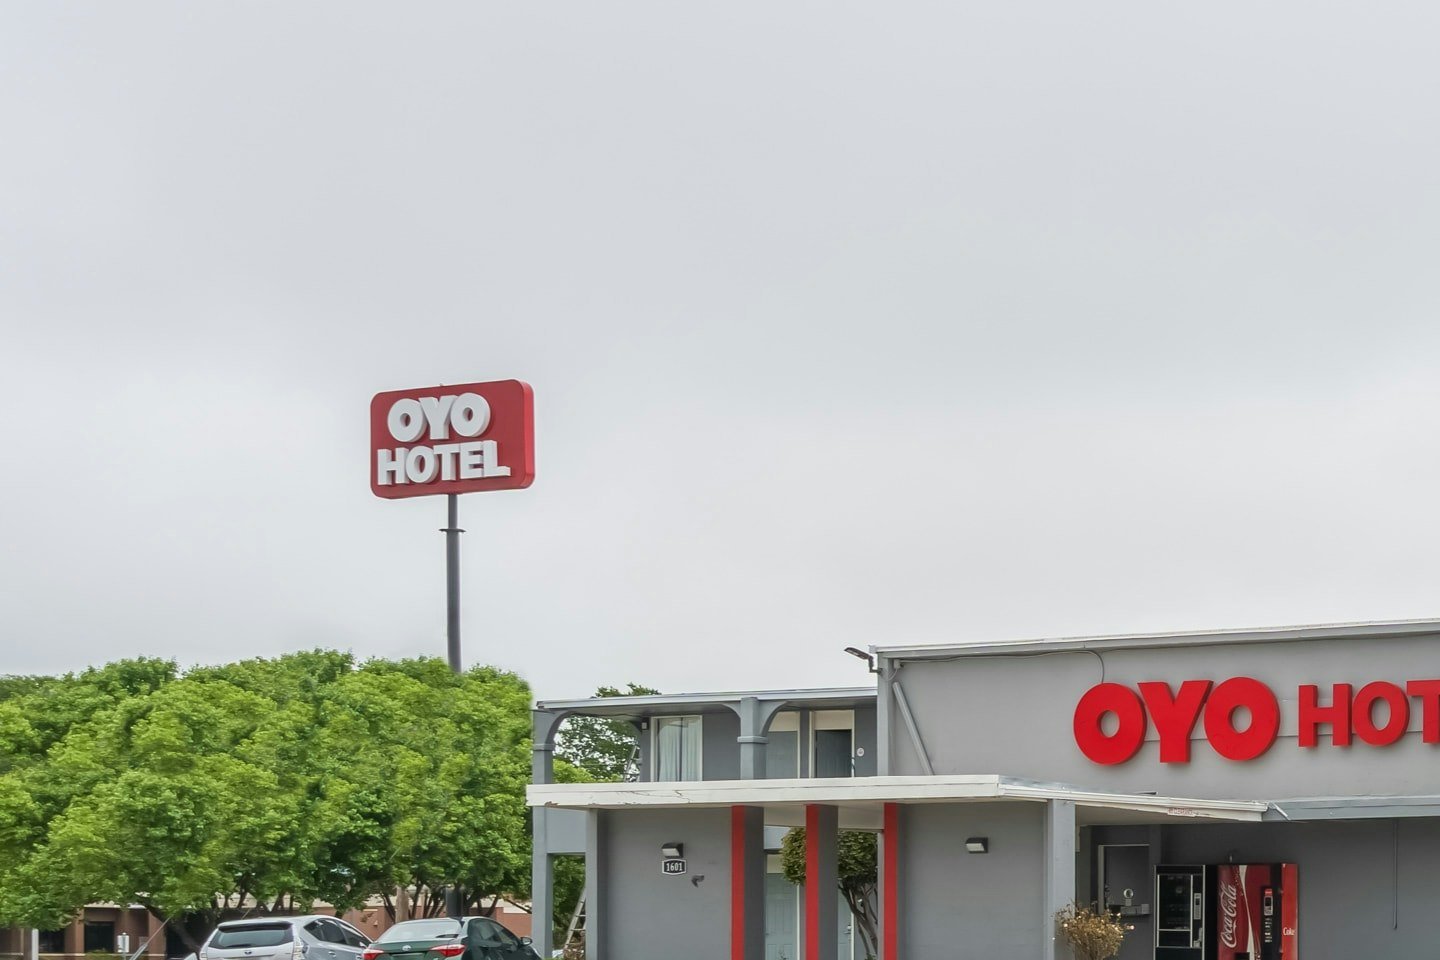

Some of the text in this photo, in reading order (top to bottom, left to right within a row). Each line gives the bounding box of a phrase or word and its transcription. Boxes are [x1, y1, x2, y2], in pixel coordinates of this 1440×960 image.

[387, 392, 491, 442] OYO
[377, 440, 511, 485] HOTEL
[1073, 677, 1280, 765] OYO
[666, 862, 683, 872] 1601
[1283, 927, 1295, 936] Coke
